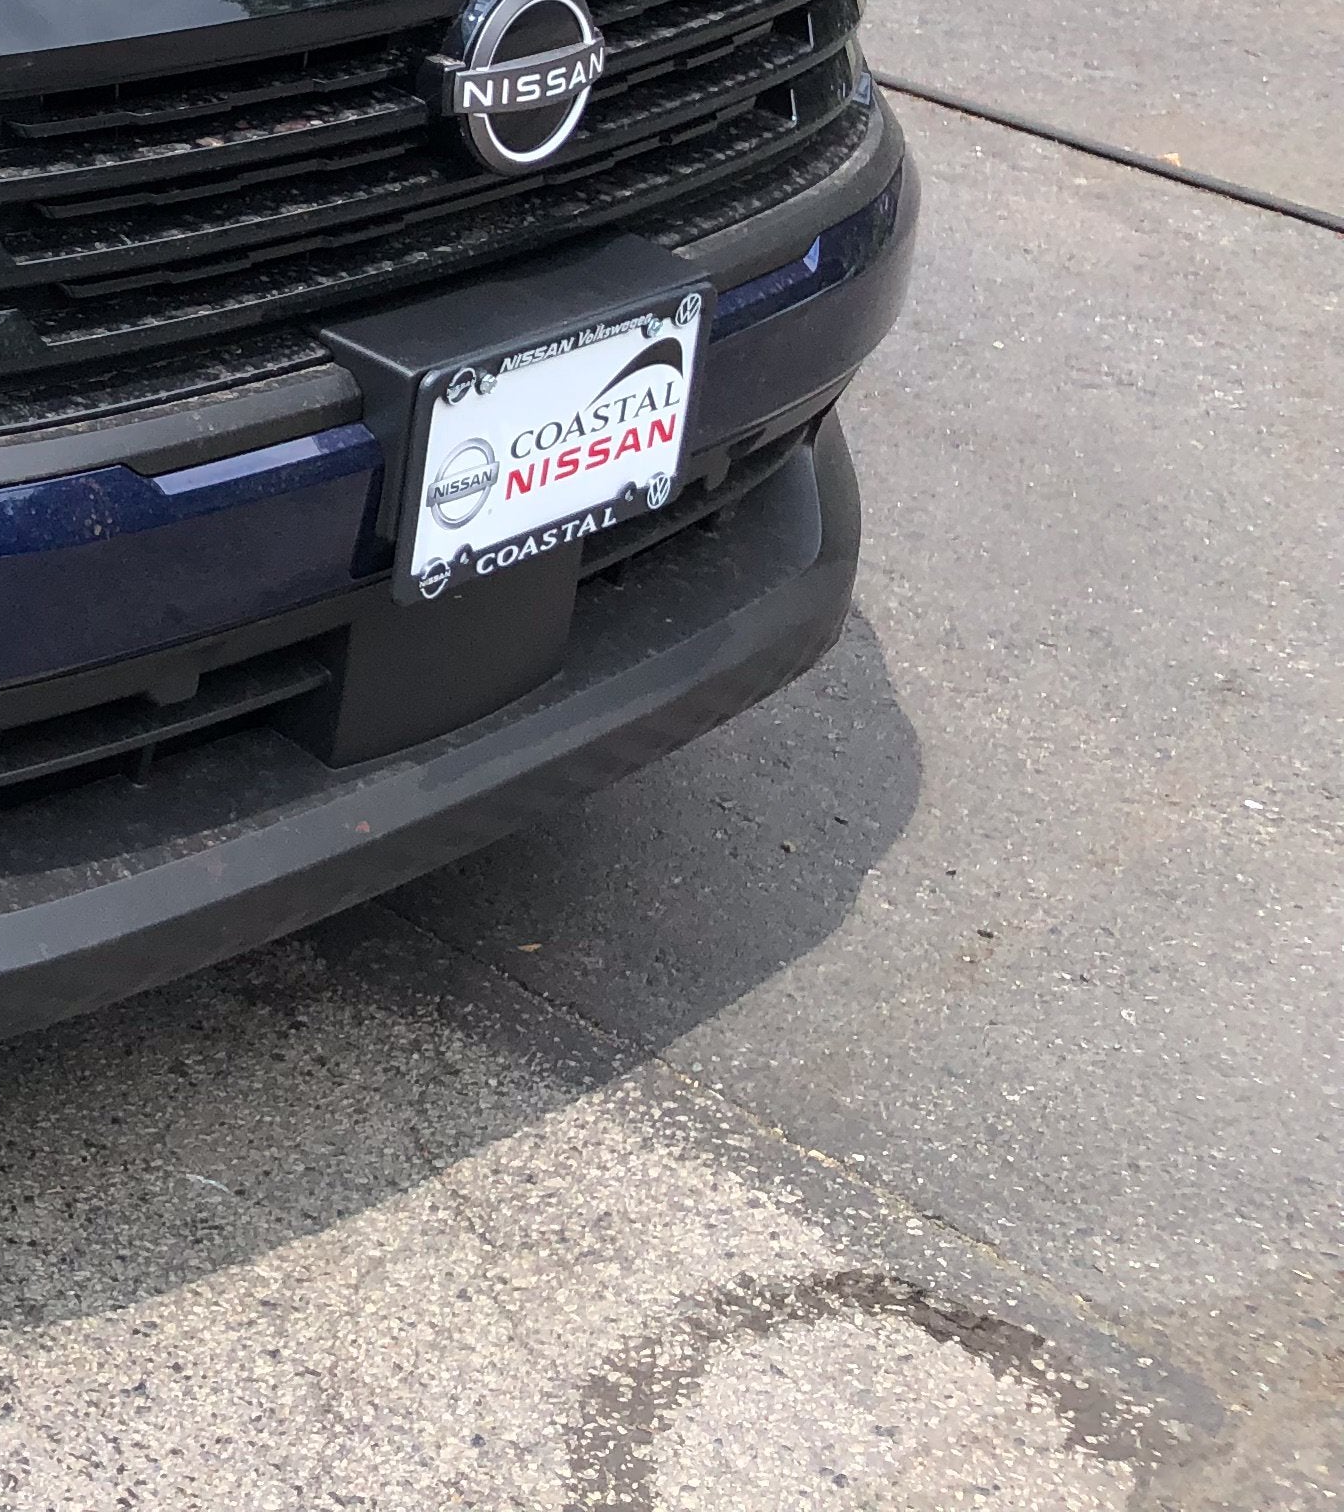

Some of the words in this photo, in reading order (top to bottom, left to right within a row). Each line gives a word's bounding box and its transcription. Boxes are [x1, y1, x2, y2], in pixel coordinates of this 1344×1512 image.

[462, 46, 605, 108] NISSAN
[500, 337, 575, 374] NISSAN
[511, 380, 681, 460] COASTAL
[433, 468, 493, 500] NISSAN
[505, 413, 677, 501] NISSAN
[476, 506, 618, 576] COASTAL
